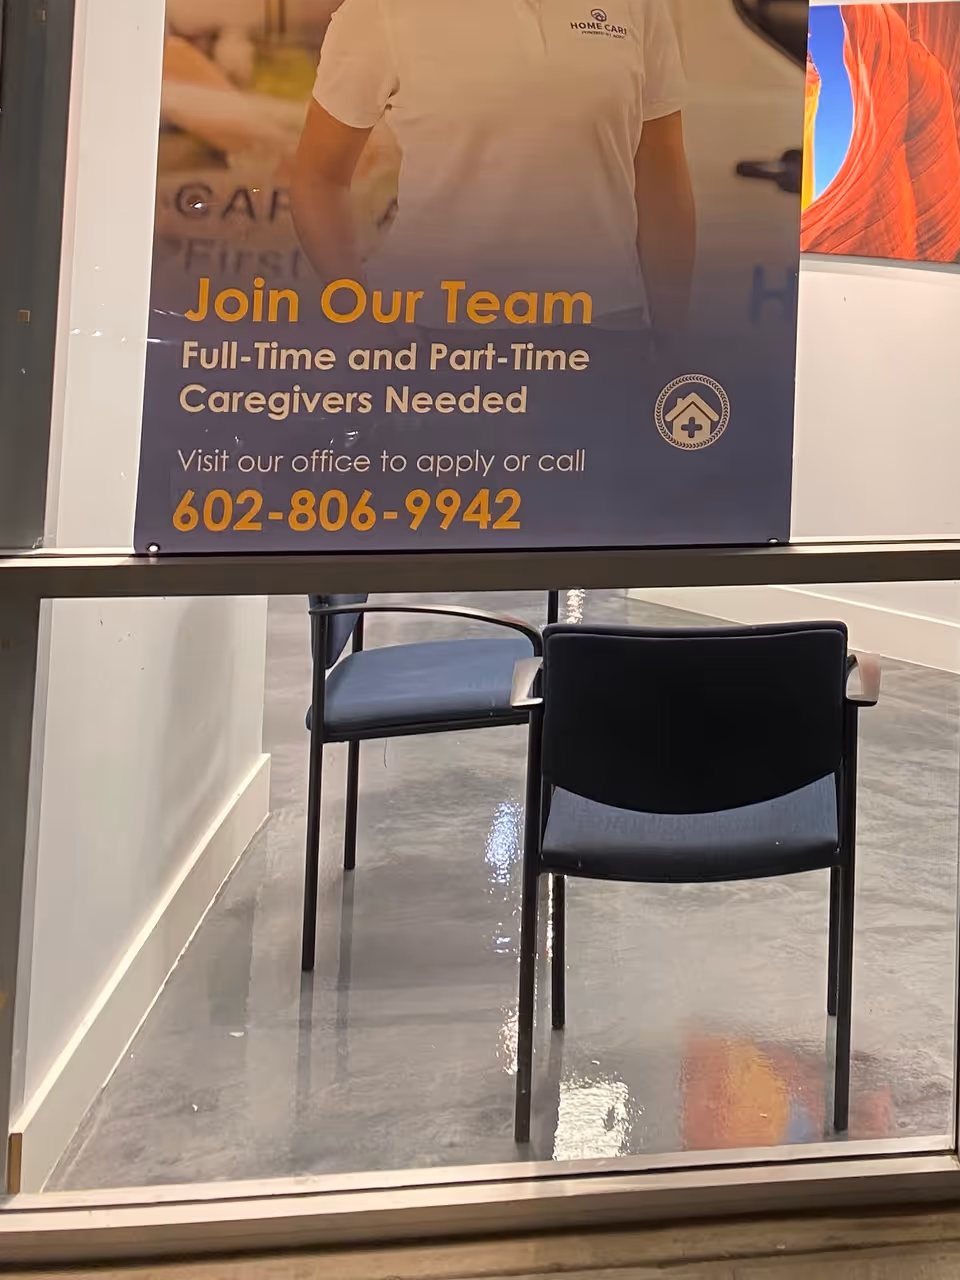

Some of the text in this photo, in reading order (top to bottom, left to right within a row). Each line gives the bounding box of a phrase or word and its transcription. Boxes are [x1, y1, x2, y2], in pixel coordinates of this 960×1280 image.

[570, 22, 603, 30] HOME
[185, 277, 593, 325] Join Our Team
[182, 340, 590, 372] Full-Time and Part-Time
[179, 384, 527, 421] Caregivers Needed
[177, 448, 585, 478] Visit our office to apply or call
[172, 488, 521, 532] 602-806-9942
